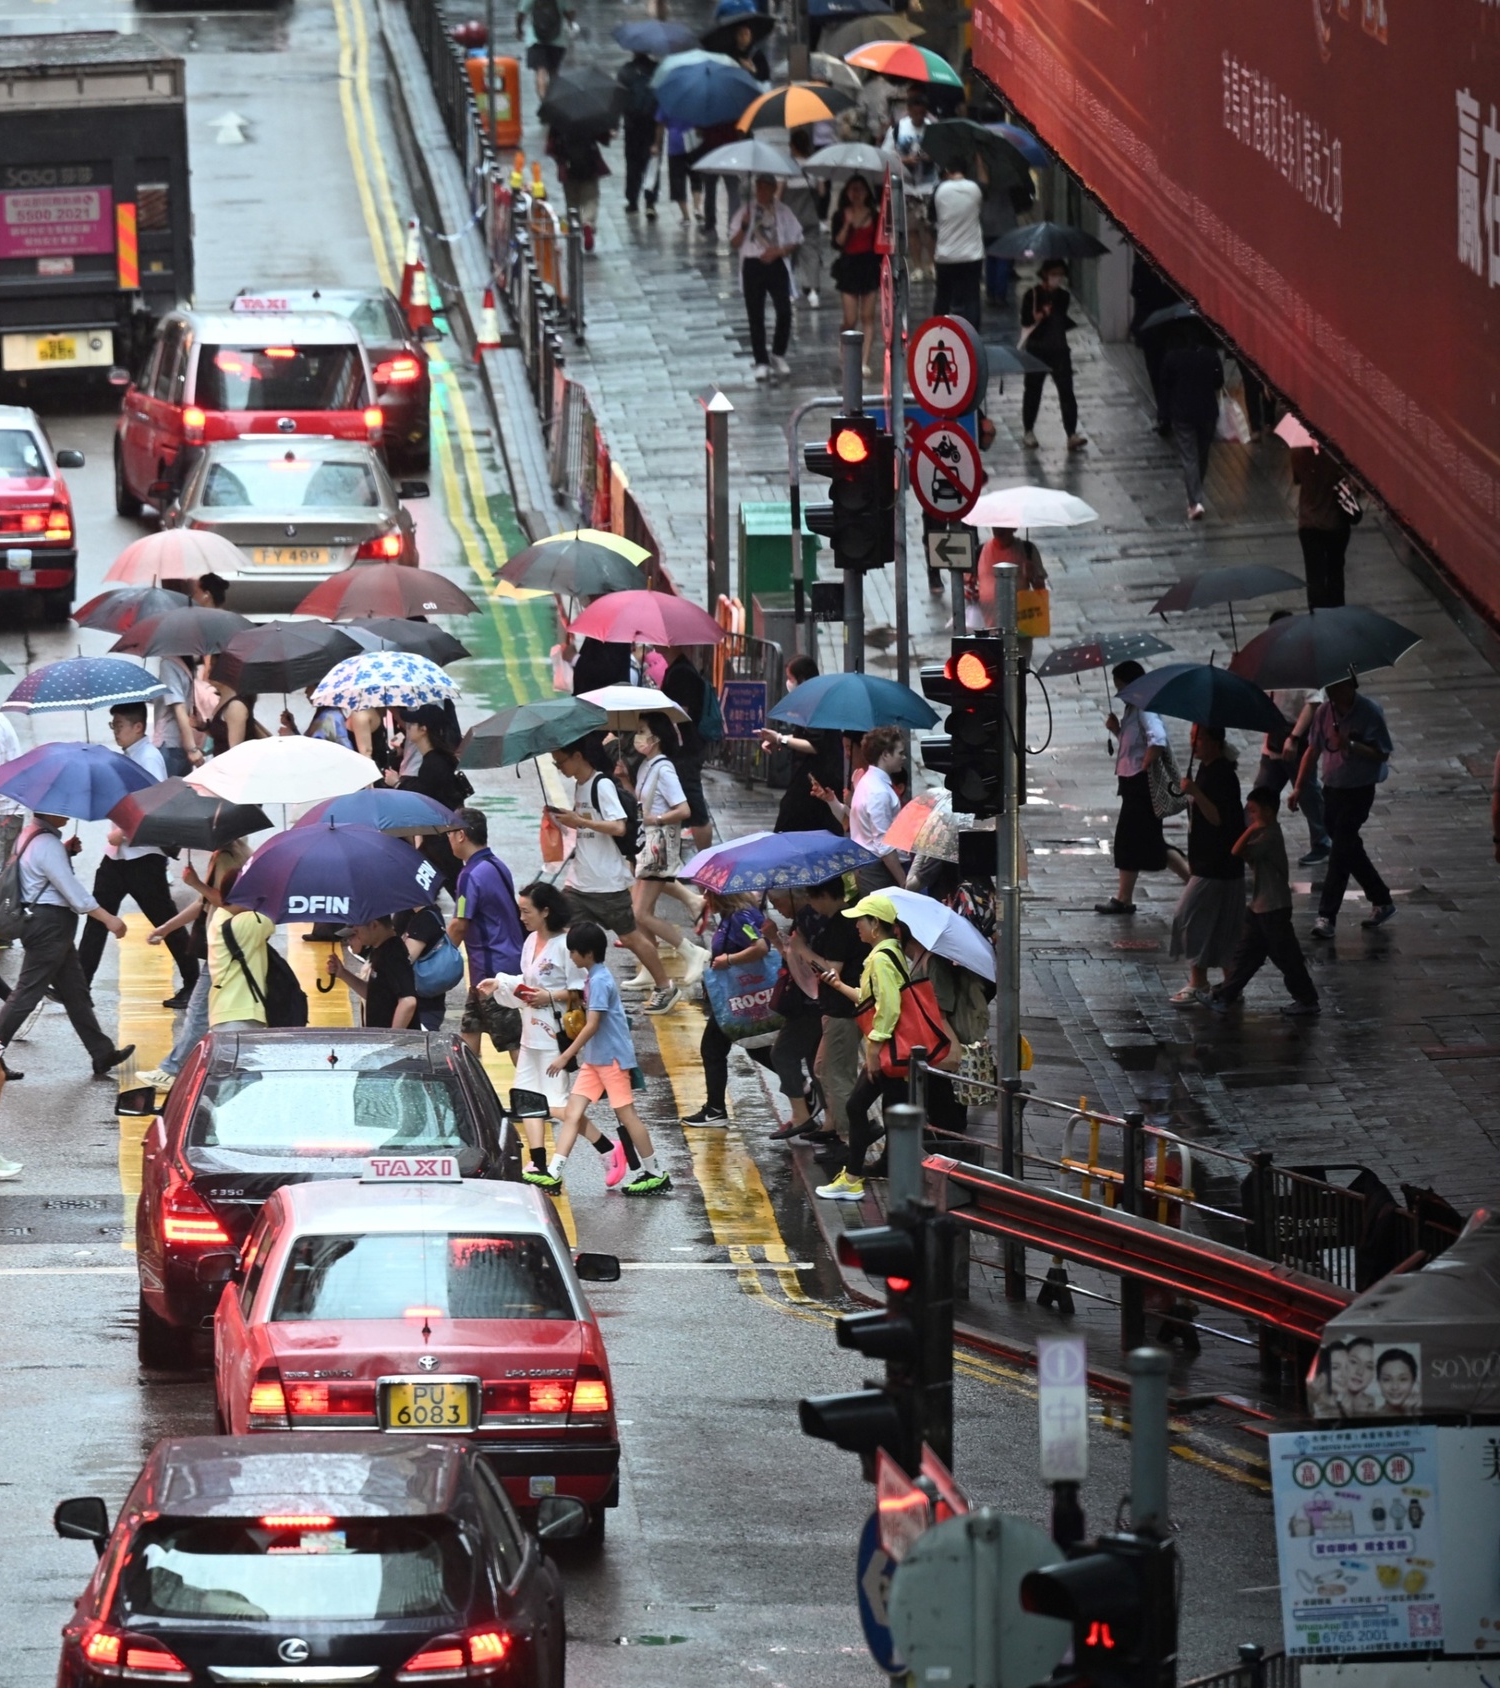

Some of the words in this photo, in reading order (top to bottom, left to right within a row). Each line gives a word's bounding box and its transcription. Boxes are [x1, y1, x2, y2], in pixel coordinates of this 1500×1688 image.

[241, 298, 288, 310] TAXI
[289, 550, 320, 563] 499
[423, 601, 438, 610] citi
[288, 895, 350, 914] DFIN
[371, 1159, 453, 1177] TAXI
[505, 1369, 526, 1377] LPG
[529, 1368, 575, 1376] COMFORT
[413, 1386, 445, 1405] PU
[397, 1407, 461, 1425] 6083
[1322, 1631, 1354, 1644] 6765
[1358, 1629, 1389, 1643] 2001
